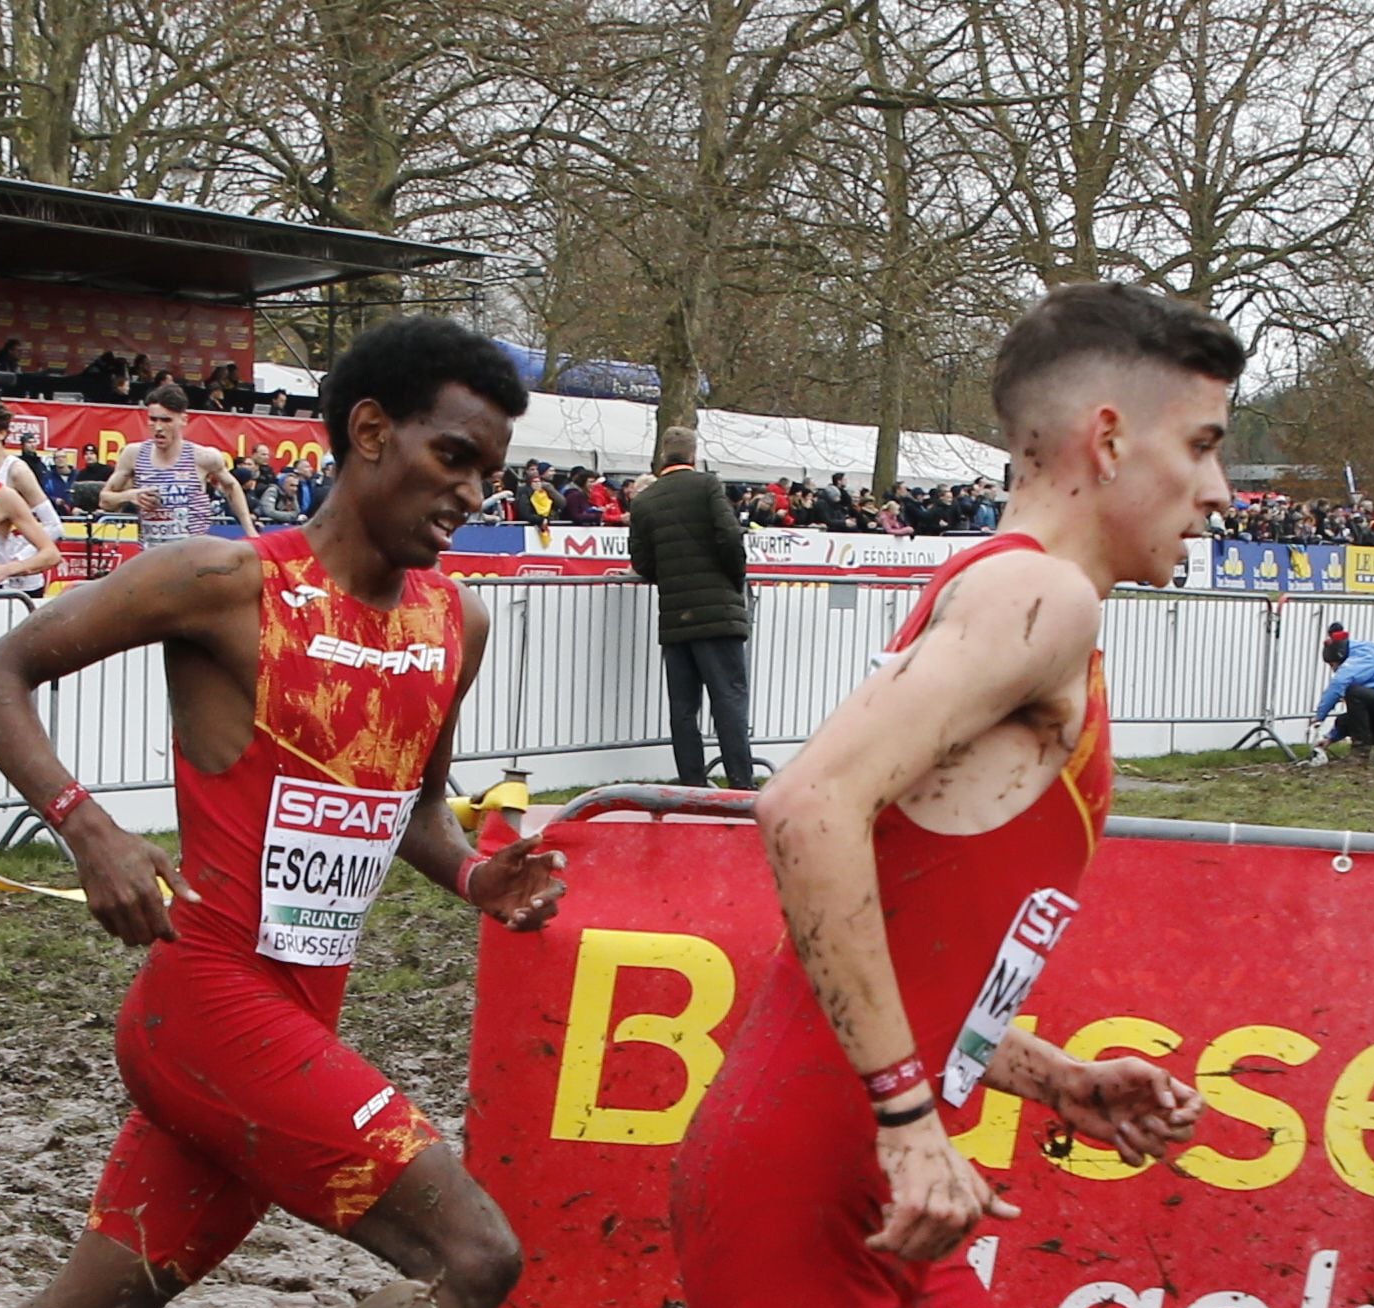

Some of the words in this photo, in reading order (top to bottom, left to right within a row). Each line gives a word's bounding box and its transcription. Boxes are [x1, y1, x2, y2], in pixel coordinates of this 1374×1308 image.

[1355, 553, 1370, 571] LE
[306, 633, 446, 675] ESPAÑA
[278, 790, 399, 835] SPAR
[298, 909, 335, 927] RUN
[351, 1085, 396, 1131] ESP
